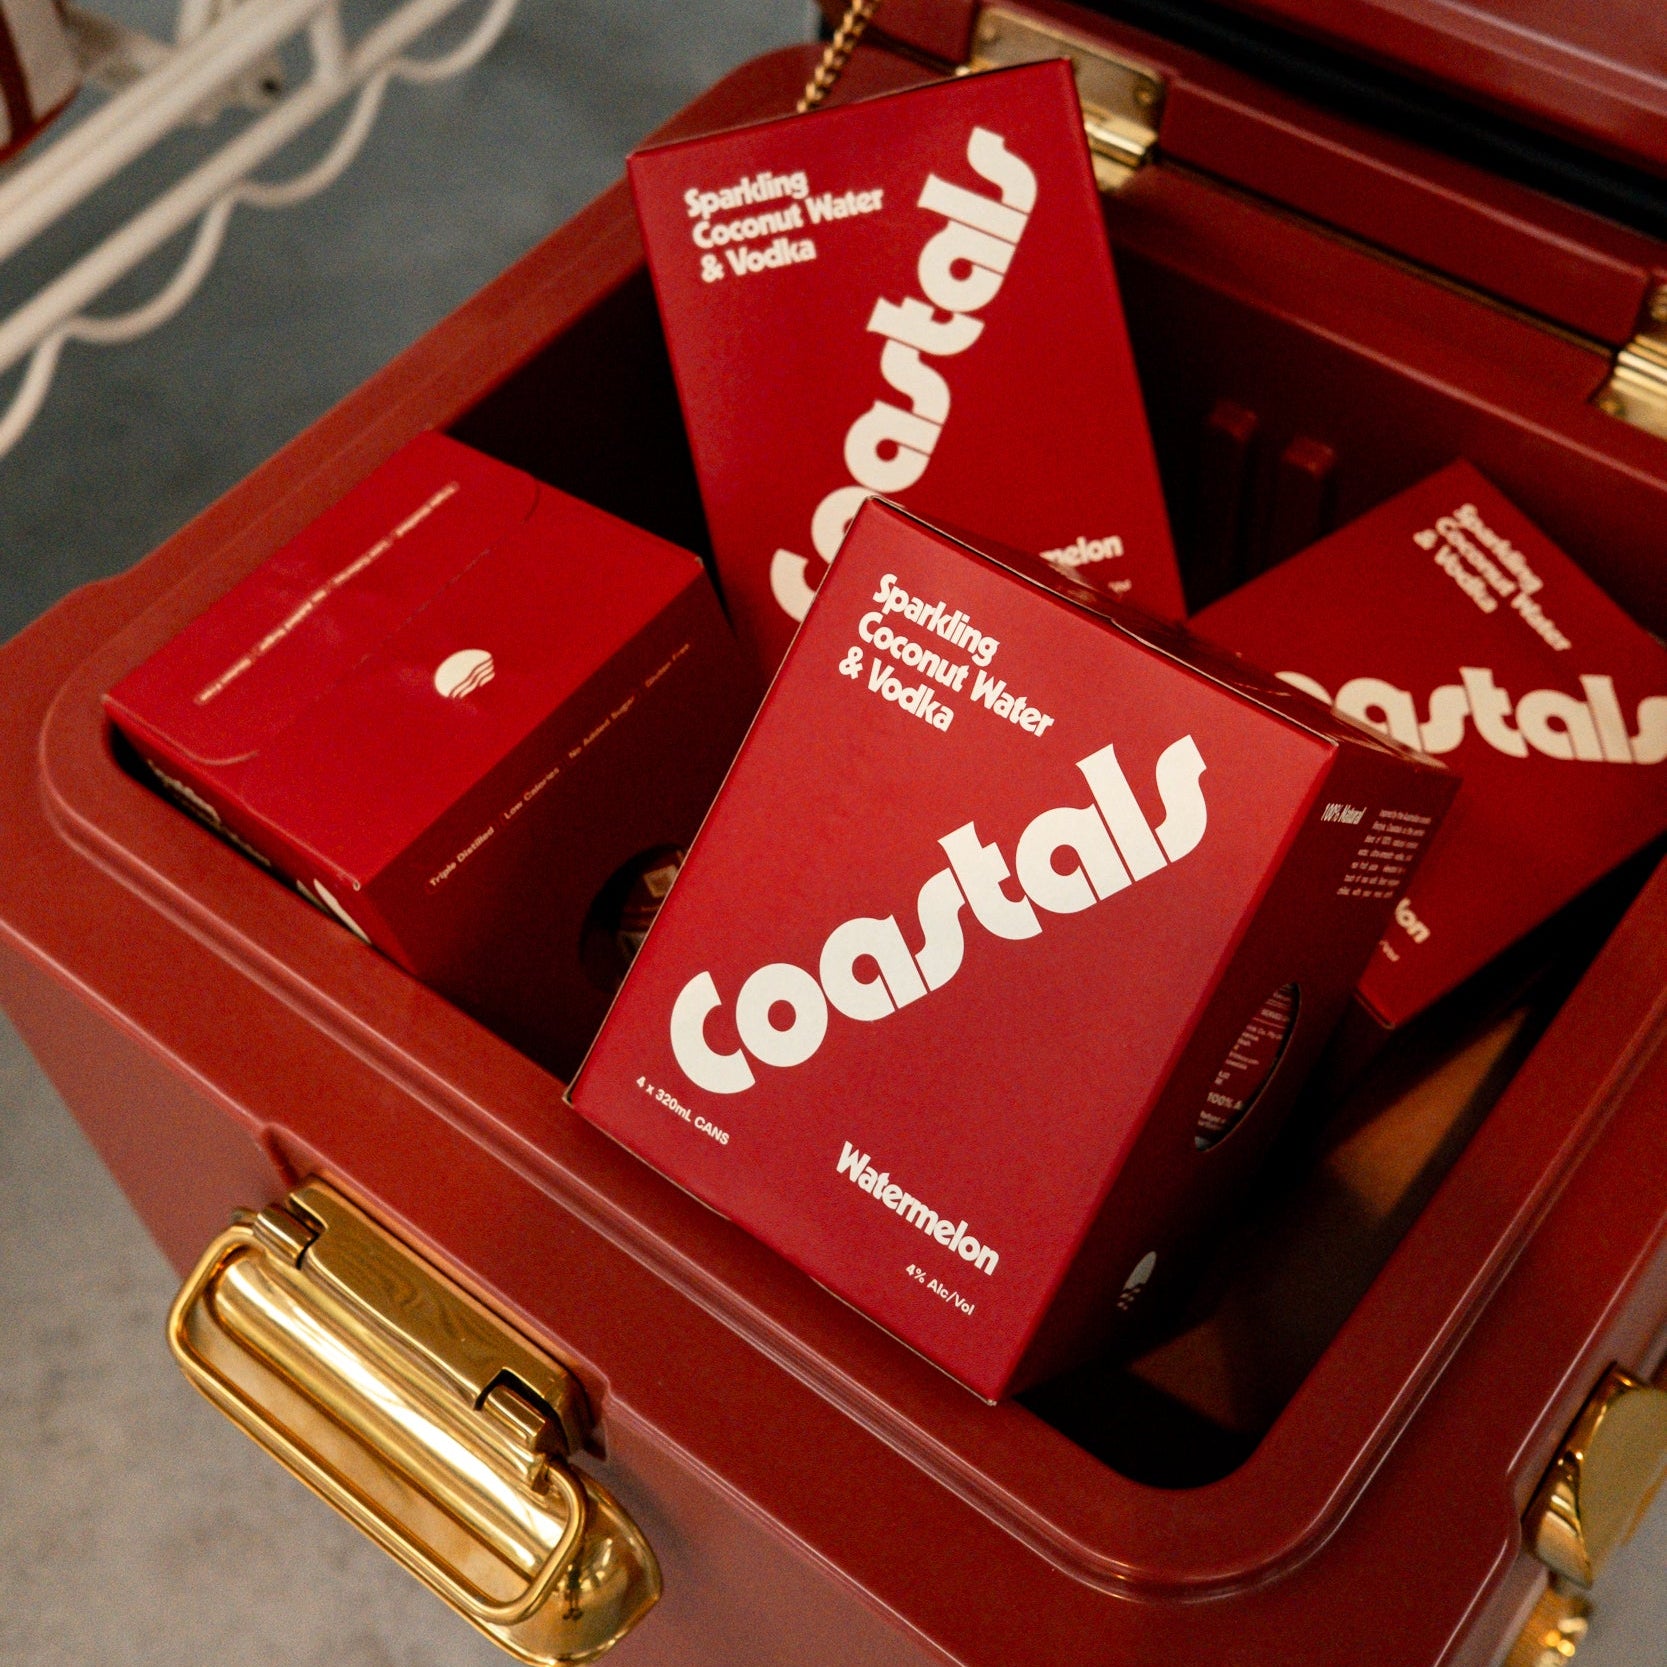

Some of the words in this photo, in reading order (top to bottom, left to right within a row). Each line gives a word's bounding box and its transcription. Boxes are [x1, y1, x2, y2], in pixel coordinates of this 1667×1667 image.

[684, 172, 809, 219] Sparkling
[692, 204, 803, 248] Coconut
[805, 189, 883, 224] Water
[701, 254, 724, 282] &
[725, 238, 816, 275] Vodka
[873, 574, 1000, 667] Sparkling
[839, 646, 863, 679] &
[868, 658, 954, 732] Vodka
[859, 612, 969, 692] Coconut
[969, 669, 1055, 738] Water
[1274, 668, 1667, 764] astals
[430, 863, 456, 885] Triple
[457, 827, 494, 862] Distilled
[504, 802, 522, 819] Low
[1338, 805, 1367, 824] Natural
[671, 734, 1207, 1094] coastals
[635, 1075, 647, 1089] 4
[646, 1084, 656, 1097] x
[655, 1089, 691, 1122] 320mL
[694, 1116, 729, 1145] CANS
[836, 1141, 999, 1275] Watermelon
[906, 1264, 926, 1283] 4%
[927, 1279, 975, 1315] Alc/Vol
